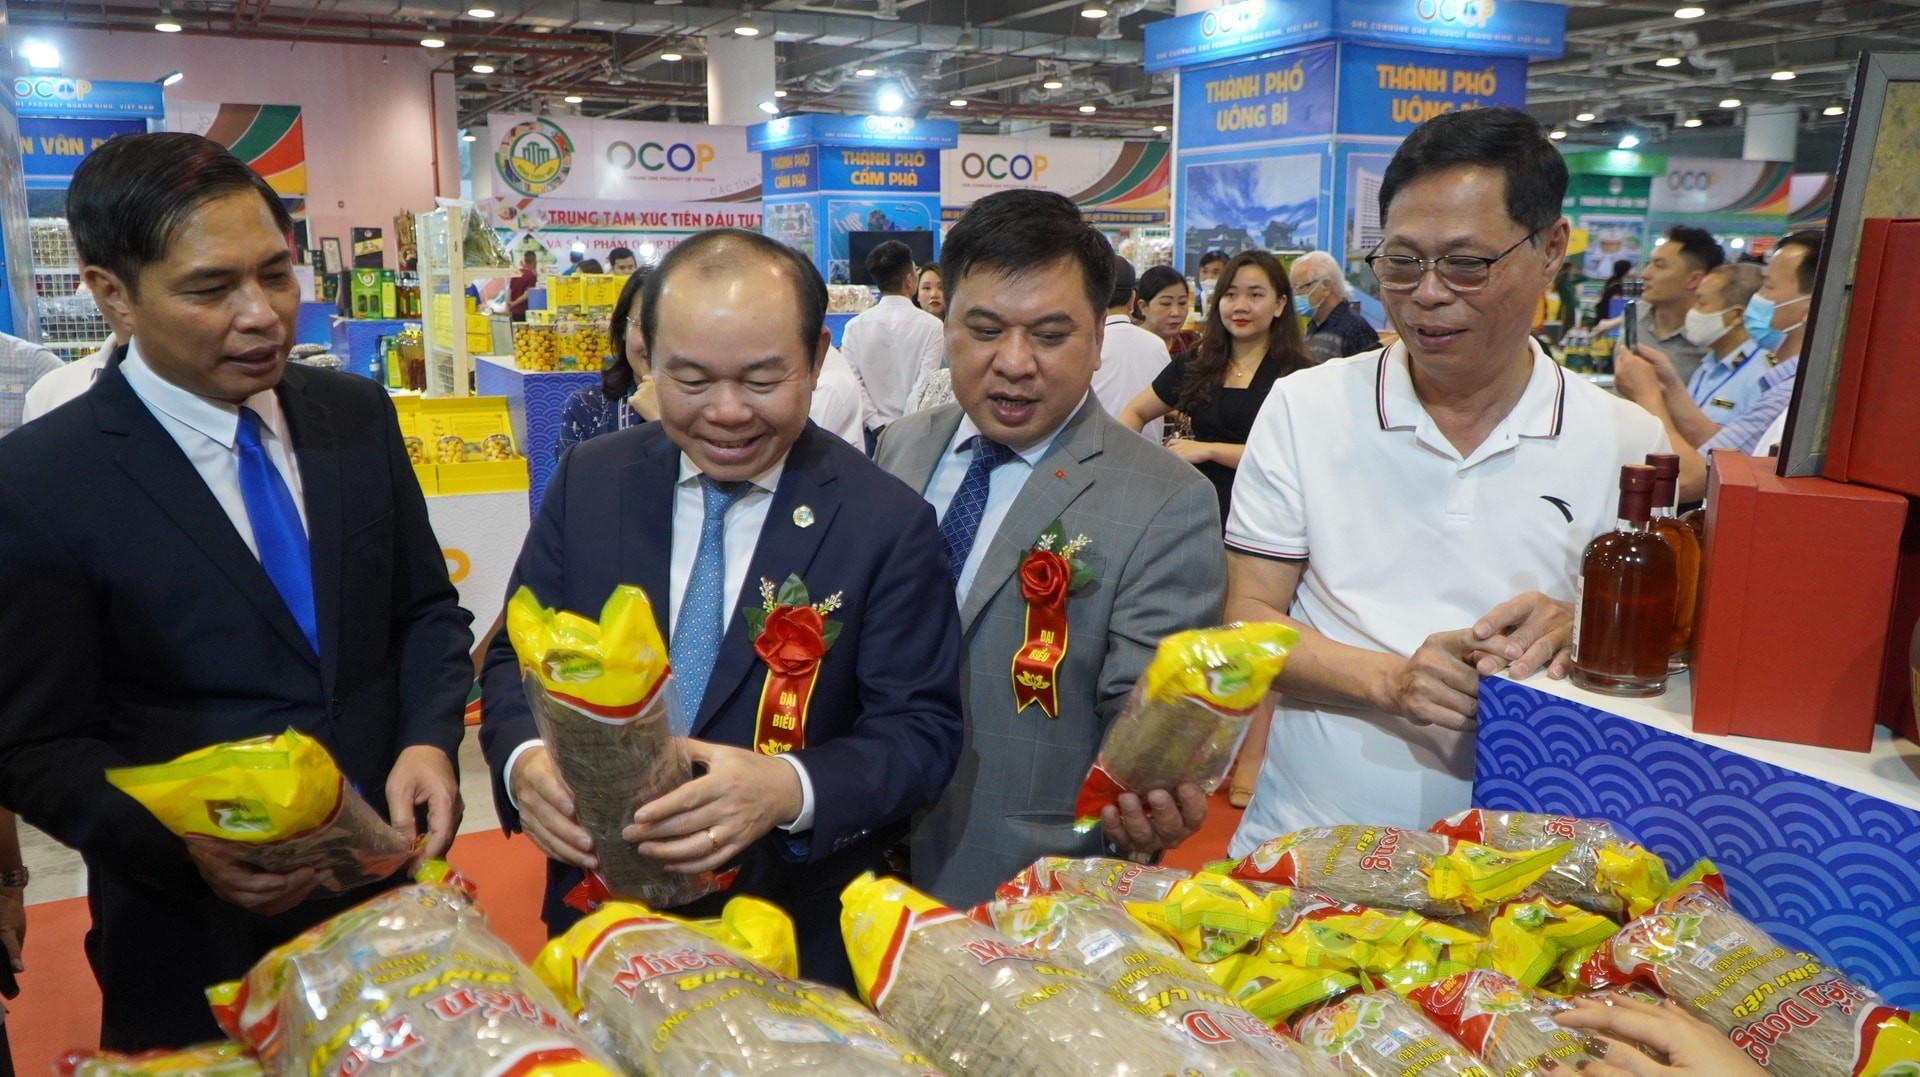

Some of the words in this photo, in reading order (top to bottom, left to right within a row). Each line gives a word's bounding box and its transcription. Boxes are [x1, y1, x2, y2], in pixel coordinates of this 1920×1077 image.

[14, 78, 92, 101] OCOP
[1205, 72, 1260, 103] THÀNH
[1265, 59, 1304, 95] PHỐ
[1376, 62, 1447, 93] THÀNH
[1453, 65, 1496, 96] PHỐ
[1216, 104, 1266, 132] UÔNG
[1271, 97, 1288, 126] BÍ
[606, 140, 715, 173] OCOP
[842, 149, 890, 166] THÀNH
[895, 151, 926, 167] PHỐ
[961, 152, 1048, 181] OCOP
[850, 166, 884, 186] CẨM
[888, 168, 918, 186] PHẢ
[1666, 170, 1720, 191] OCOP
[548, 210, 599, 225] TRUNG
[603, 209, 636, 226] TÂM
[640, 210, 668, 226] XÚC
[672, 209, 701, 227] TIẾN
[705, 209, 734, 227] ĐẦU
[546, 239, 561, 249] VÀ
[566, 236, 589, 249] SN
[1040, 630, 1055, 648] ĐẠI
[1028, 648, 1050, 663] BIỂU
[779, 692, 796, 709] ĐẠI
[772, 711, 796, 731] BIỂU
[1356, 827, 1375, 852] IÊU
[1360, 827, 1400, 873] ong
[1772, 947, 1785, 959] CP
[1774, 962, 1820, 987] BÌNH
[1711, 989, 1722, 997] &
[1732, 982, 1775, 1018] LIÊU
[1728, 999, 1820, 1066] Dong
